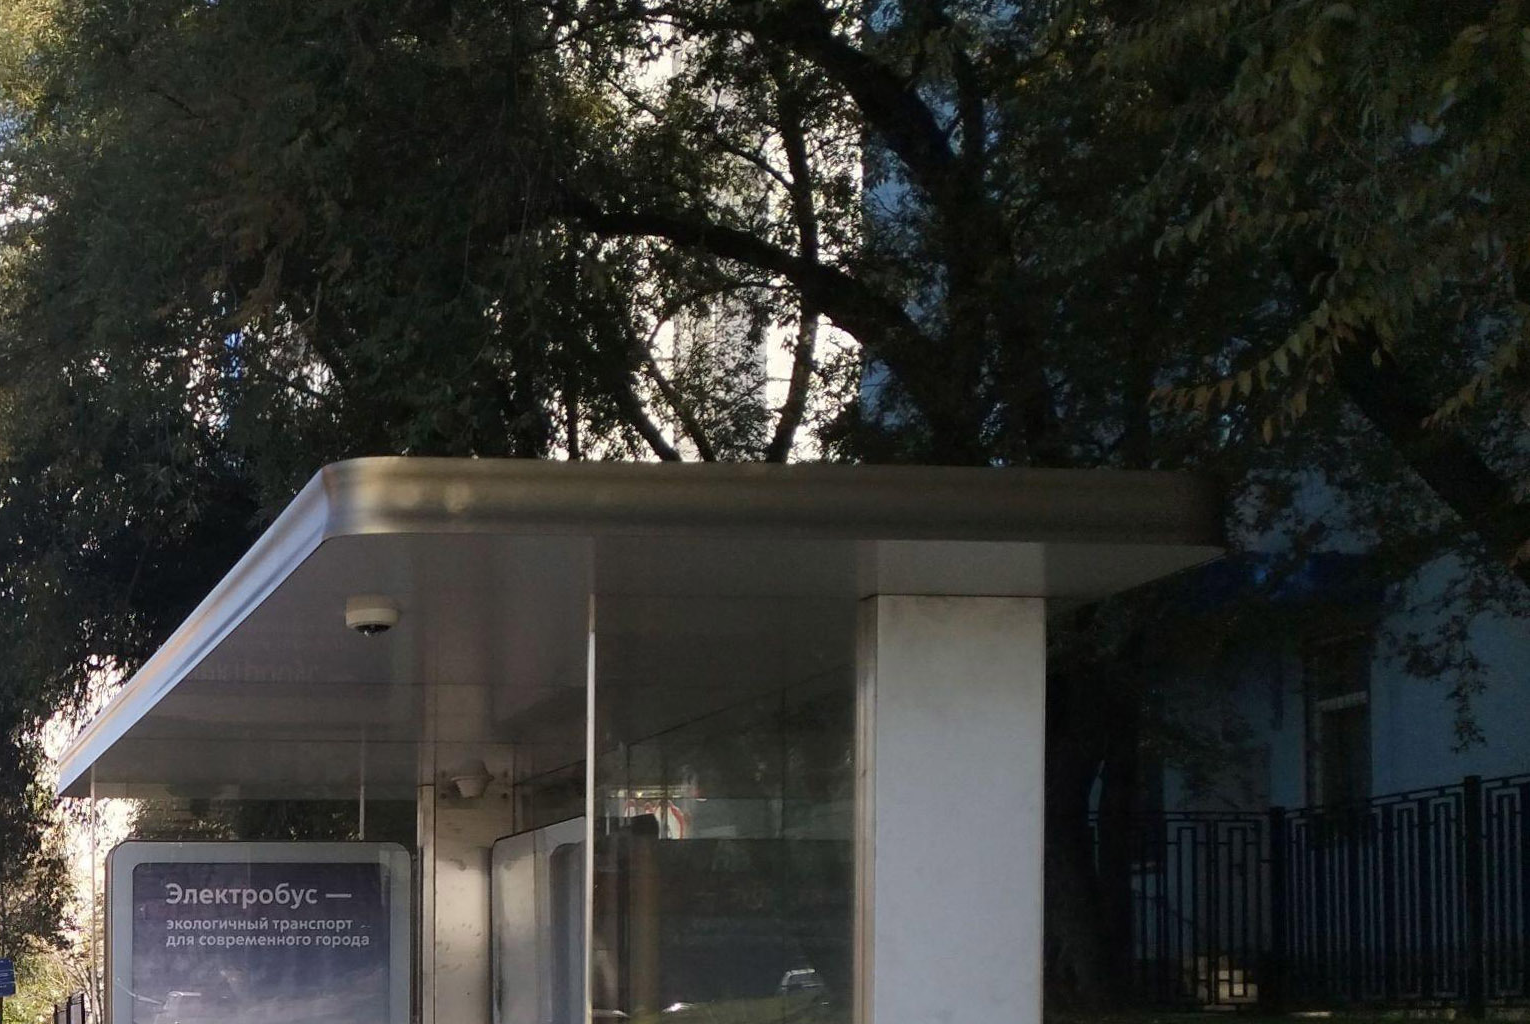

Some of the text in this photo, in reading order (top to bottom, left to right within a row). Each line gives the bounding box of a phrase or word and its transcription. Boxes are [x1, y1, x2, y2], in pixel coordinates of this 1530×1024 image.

[165, 883, 318, 909] Электробус
[166, 917, 354, 932] экологичный транспорт
[165, 935, 369, 948] для современного города
